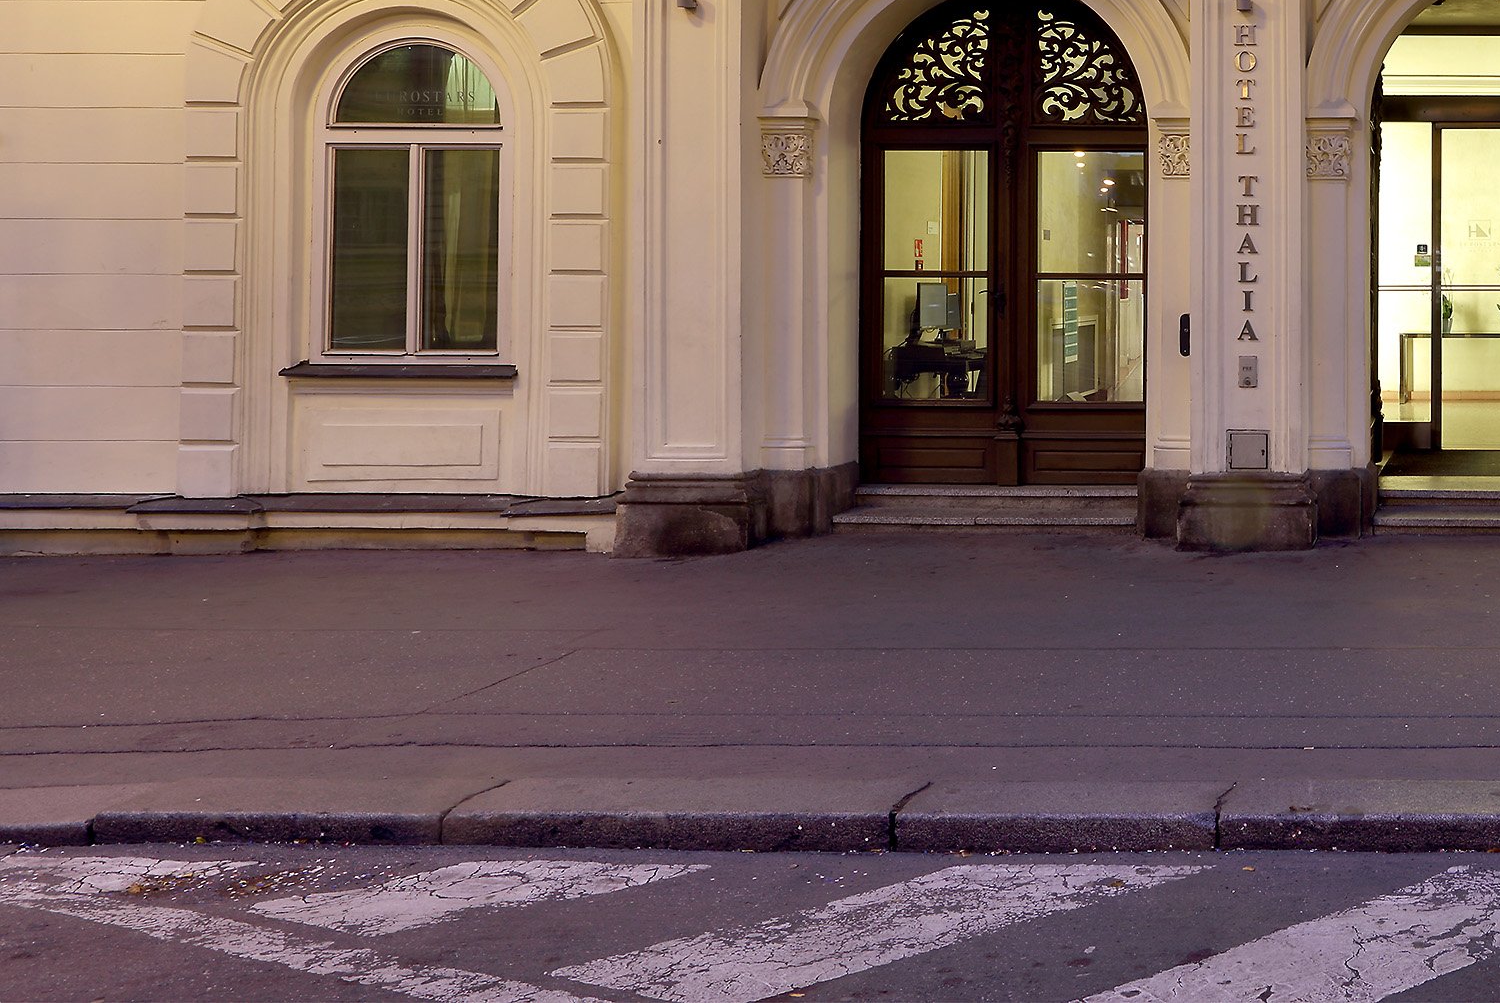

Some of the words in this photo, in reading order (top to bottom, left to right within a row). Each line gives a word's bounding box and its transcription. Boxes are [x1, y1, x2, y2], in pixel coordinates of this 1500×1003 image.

[375, 90, 476, 104] EUROSTARS
[1233, 24, 1258, 156] HOTEL
[1235, 175, 1260, 342] THALIA
